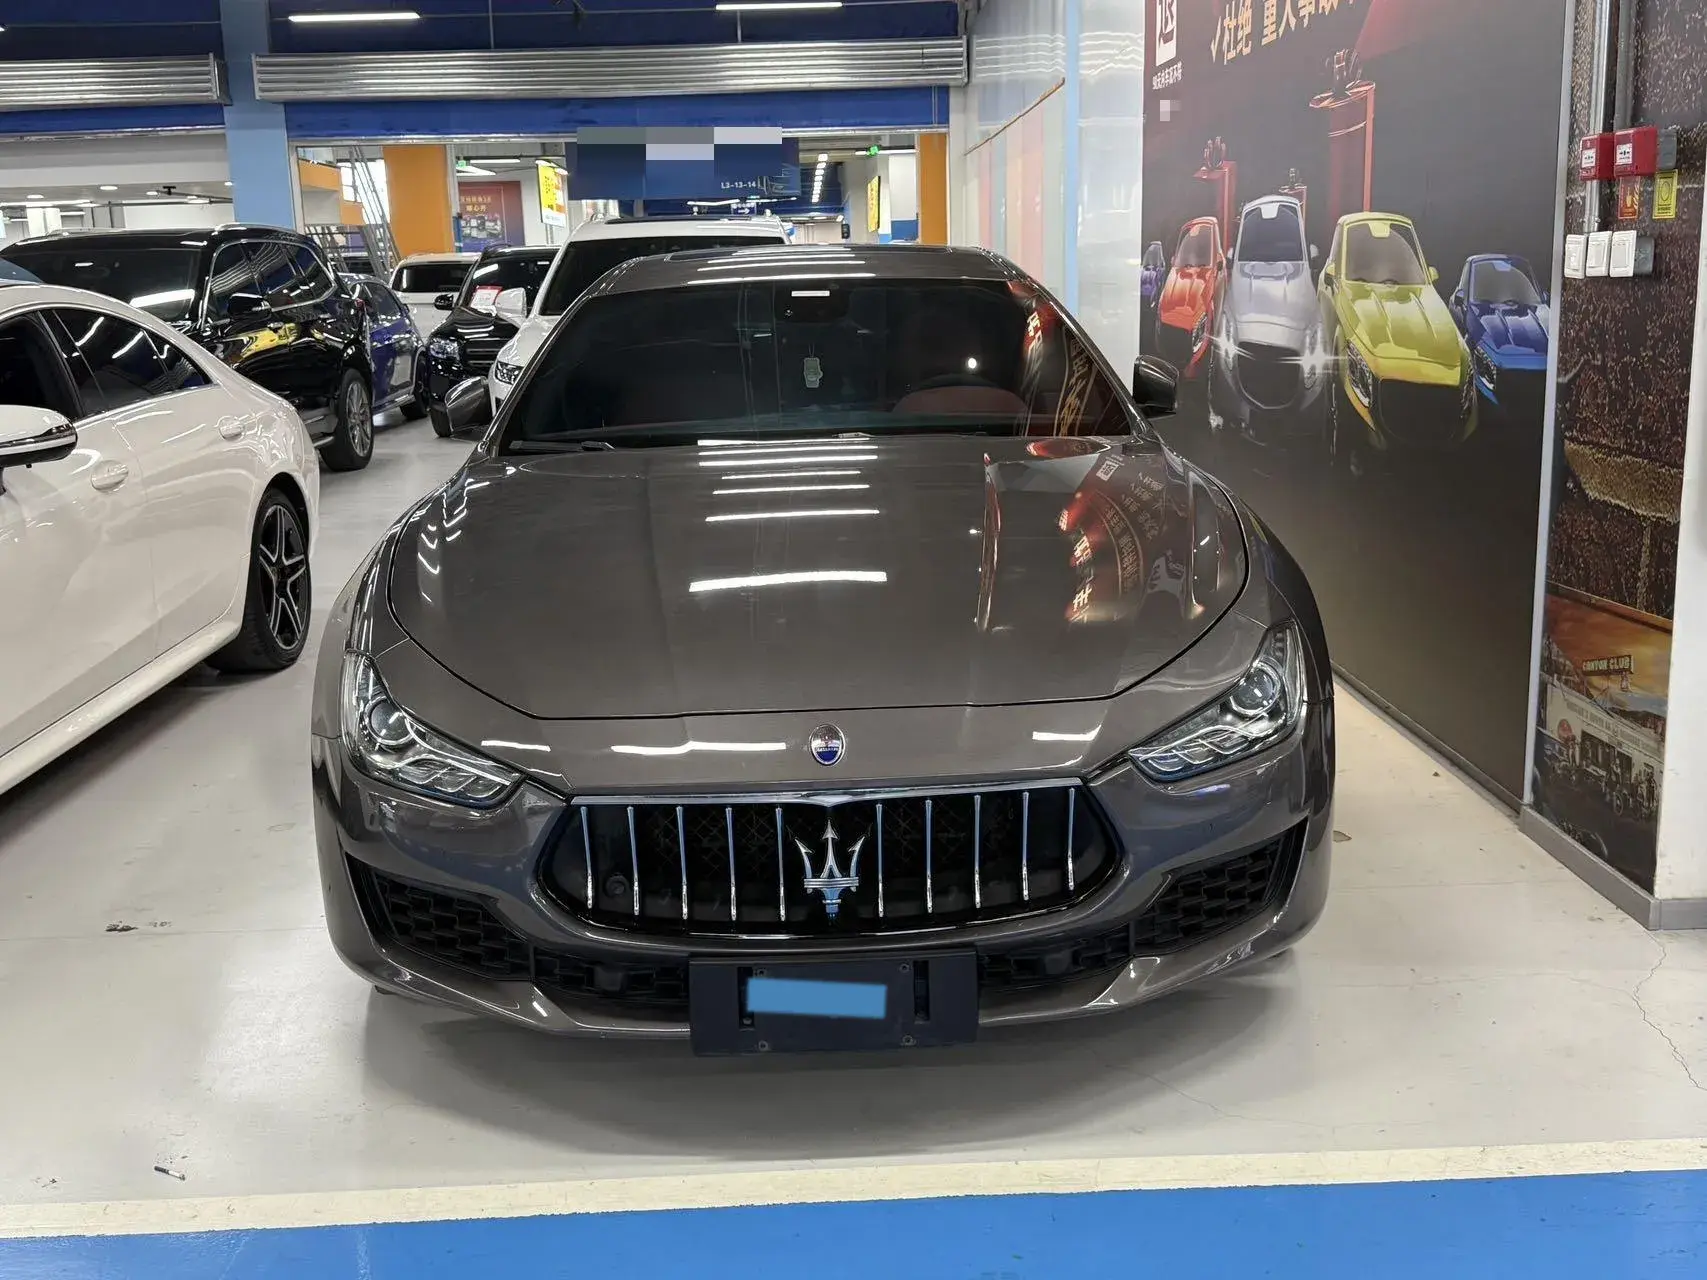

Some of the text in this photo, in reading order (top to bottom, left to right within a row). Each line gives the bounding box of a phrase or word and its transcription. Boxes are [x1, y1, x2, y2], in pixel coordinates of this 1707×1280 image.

[1222, 0, 1252, 65] 杜绝
[721, 181, 756, 189] L3-13-14
[1609, 657, 1630, 670] CLUB
